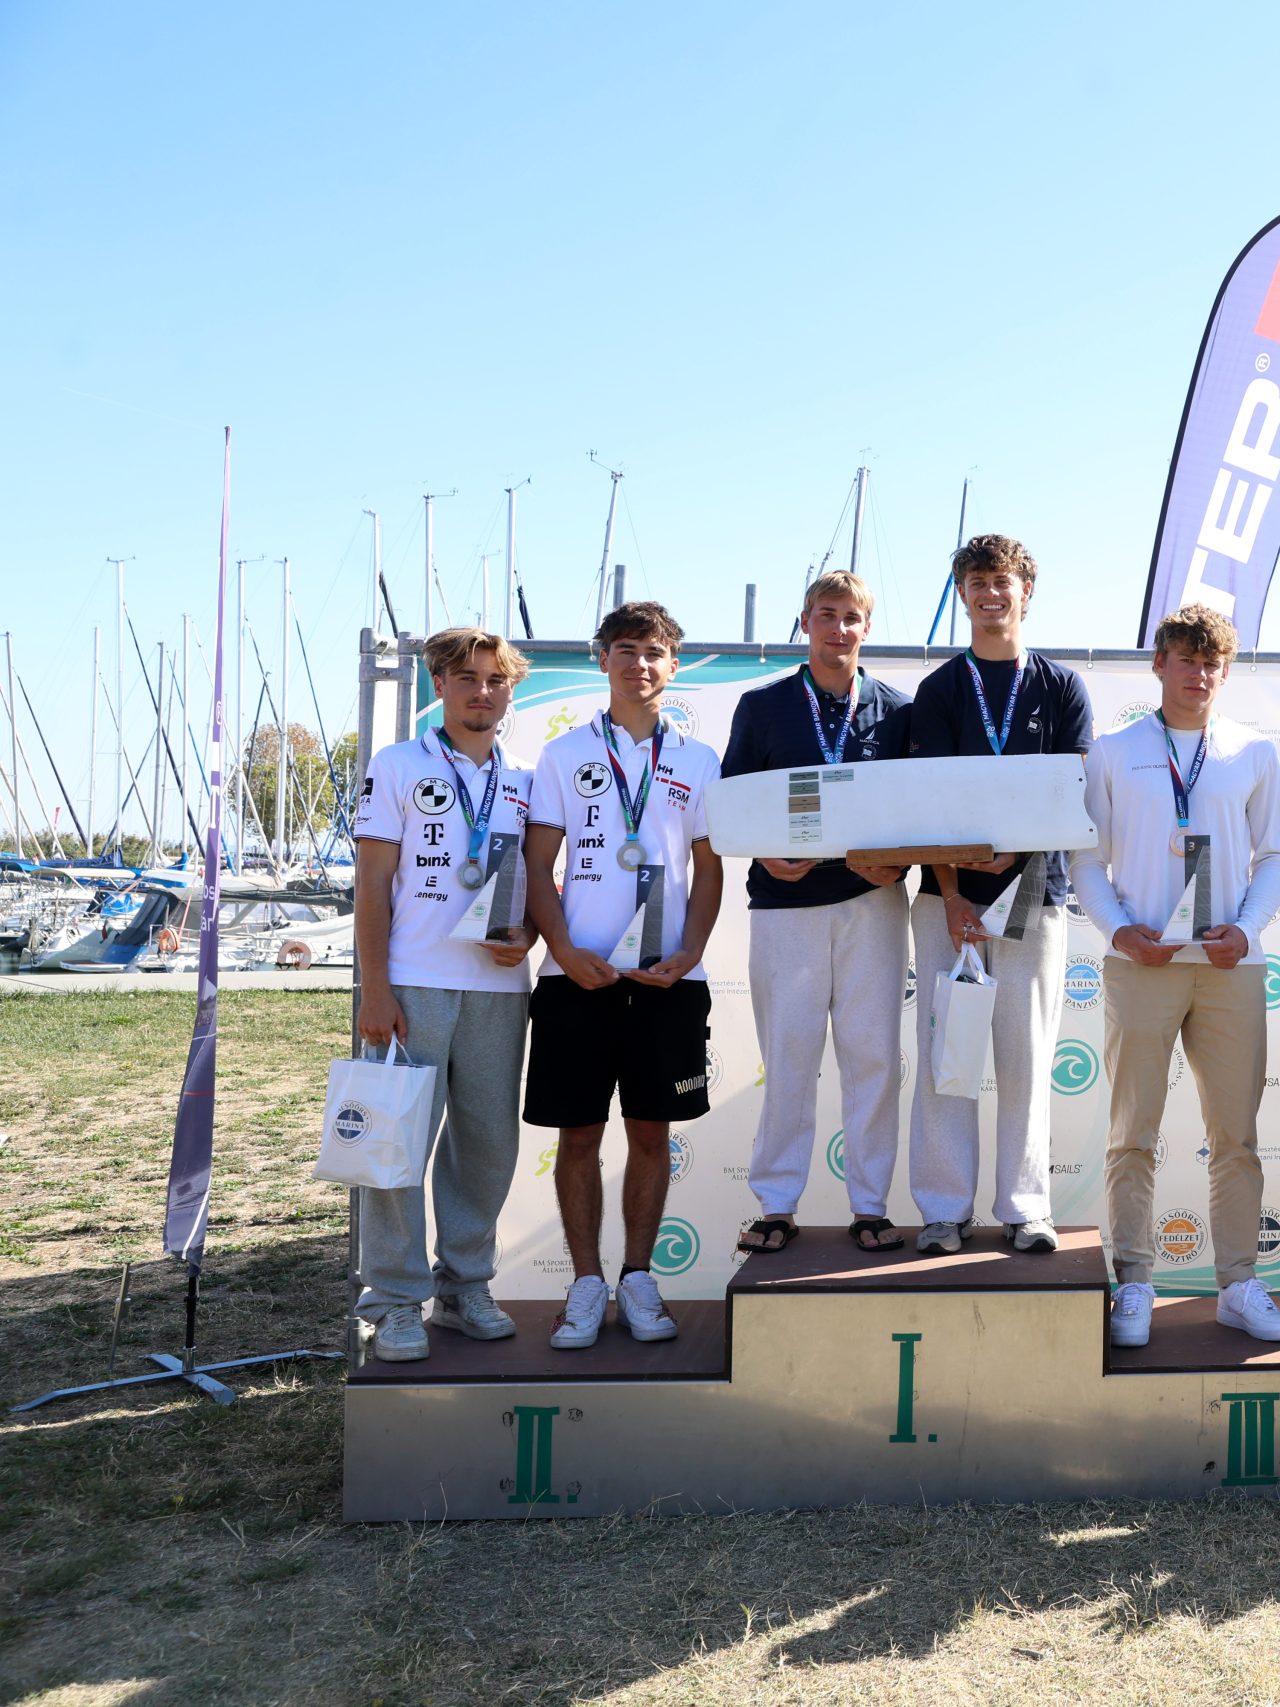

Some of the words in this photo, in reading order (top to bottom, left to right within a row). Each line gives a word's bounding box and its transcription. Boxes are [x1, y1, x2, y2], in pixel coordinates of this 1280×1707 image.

[578, 764, 606, 776] BMW
[656, 763, 673, 776] HH
[418, 780, 449, 790] BMW
[502, 784, 518, 795] HH
[668, 787, 690, 804] RSM
[516, 807, 527, 820] RS
[492, 838, 503, 851] 2
[1188, 842, 1195, 851] 3
[571, 873, 602, 882] Lenergy
[640, 870, 650, 882] 2
[414, 891, 448, 901] Lenergy
[335, 1120, 365, 1130] MARINA
[1159, 1233, 1200, 1242] FEDÉLZET
[1160, 1250, 1198, 1263] BISZTRÓ
[889, 1333, 938, 1443] I.
[508, 1406, 577, 1504] II.
